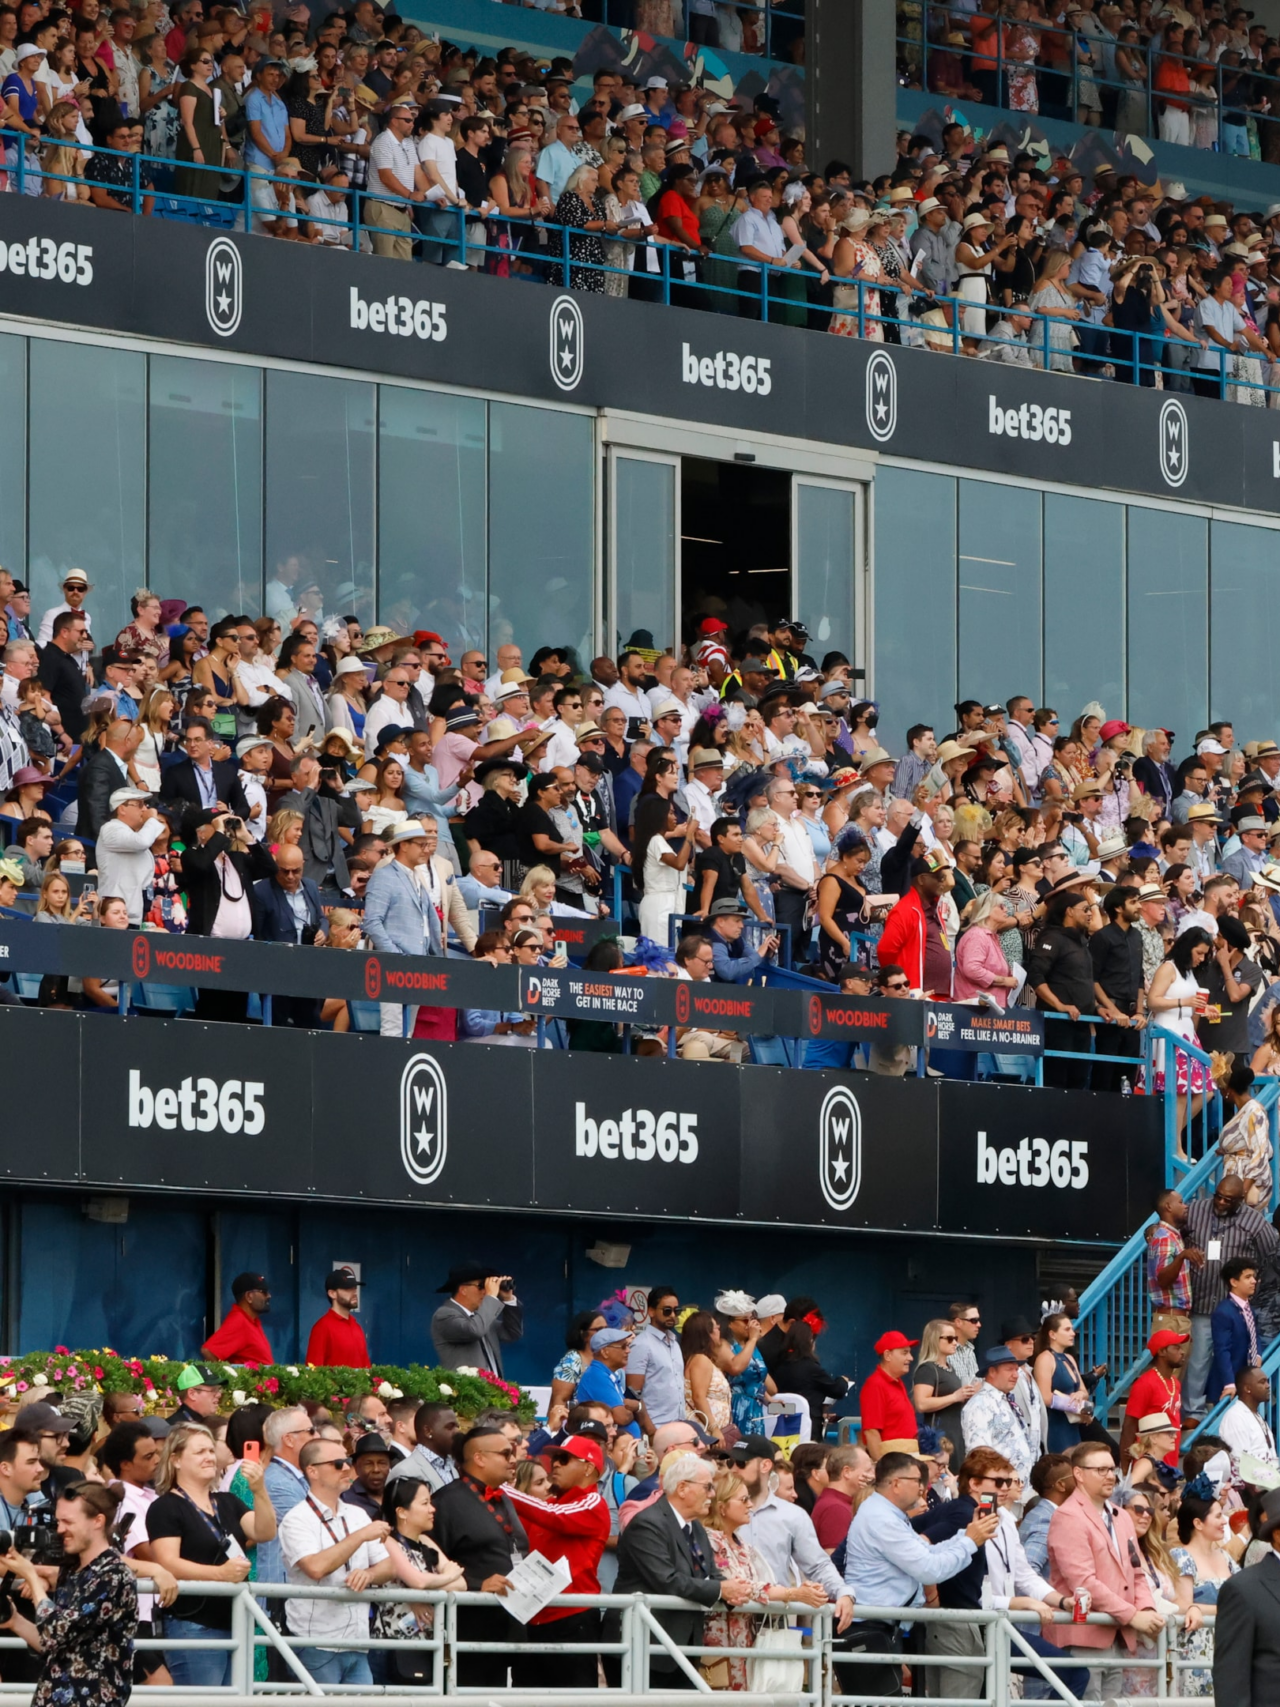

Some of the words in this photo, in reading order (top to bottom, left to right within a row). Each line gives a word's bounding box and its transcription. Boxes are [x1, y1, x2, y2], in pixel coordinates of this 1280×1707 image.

[216, 261, 232, 284] W
[350, 287, 447, 341] bet365
[559, 318, 574, 340] W
[682, 342, 772, 395] bet365
[875, 372, 888, 393] W
[989, 395, 1071, 445] bet365
[1167, 420, 1180, 440] W
[156, 951, 222, 973] WOODBINE
[386, 970, 448, 990] WOODBINE
[542, 978, 558, 988] DARK
[542, 988, 561, 998] HORSE
[569, 982, 583, 994] THE
[584, 983, 613, 997] EASIEST
[614, 986, 633, 999] WAY
[633, 988, 644, 1000] TO
[542, 997, 555, 1007] BETS
[576, 995, 591, 1008] GET
[592, 997, 601, 1009] IN
[602, 998, 616, 1010] THE
[617, 1000, 638, 1012] RACE
[694, 998, 750, 1017] WOODBINE
[826, 1010, 889, 1028] WOODBINE
[938, 1013, 953, 1022] DARK
[938, 1022, 955, 1031] HORSE
[971, 1017, 991, 1028] MAKE
[993, 1018, 1015, 1031] SMART
[1016, 1021, 1031, 1032] BETS
[938, 1031, 950, 1040] BETS
[961, 1028, 976, 1040] FEEL
[977, 1030, 991, 1041] LIKE
[992, 1032, 998, 1042] A
[999, 1032, 1040, 1045] NO-BRAINER
[129, 1070, 265, 1135] bet365
[413, 1086, 434, 1116] W
[576, 1102, 699, 1163] bet365
[832, 1117, 850, 1146] W
[977, 1131, 1089, 1189] bet365
